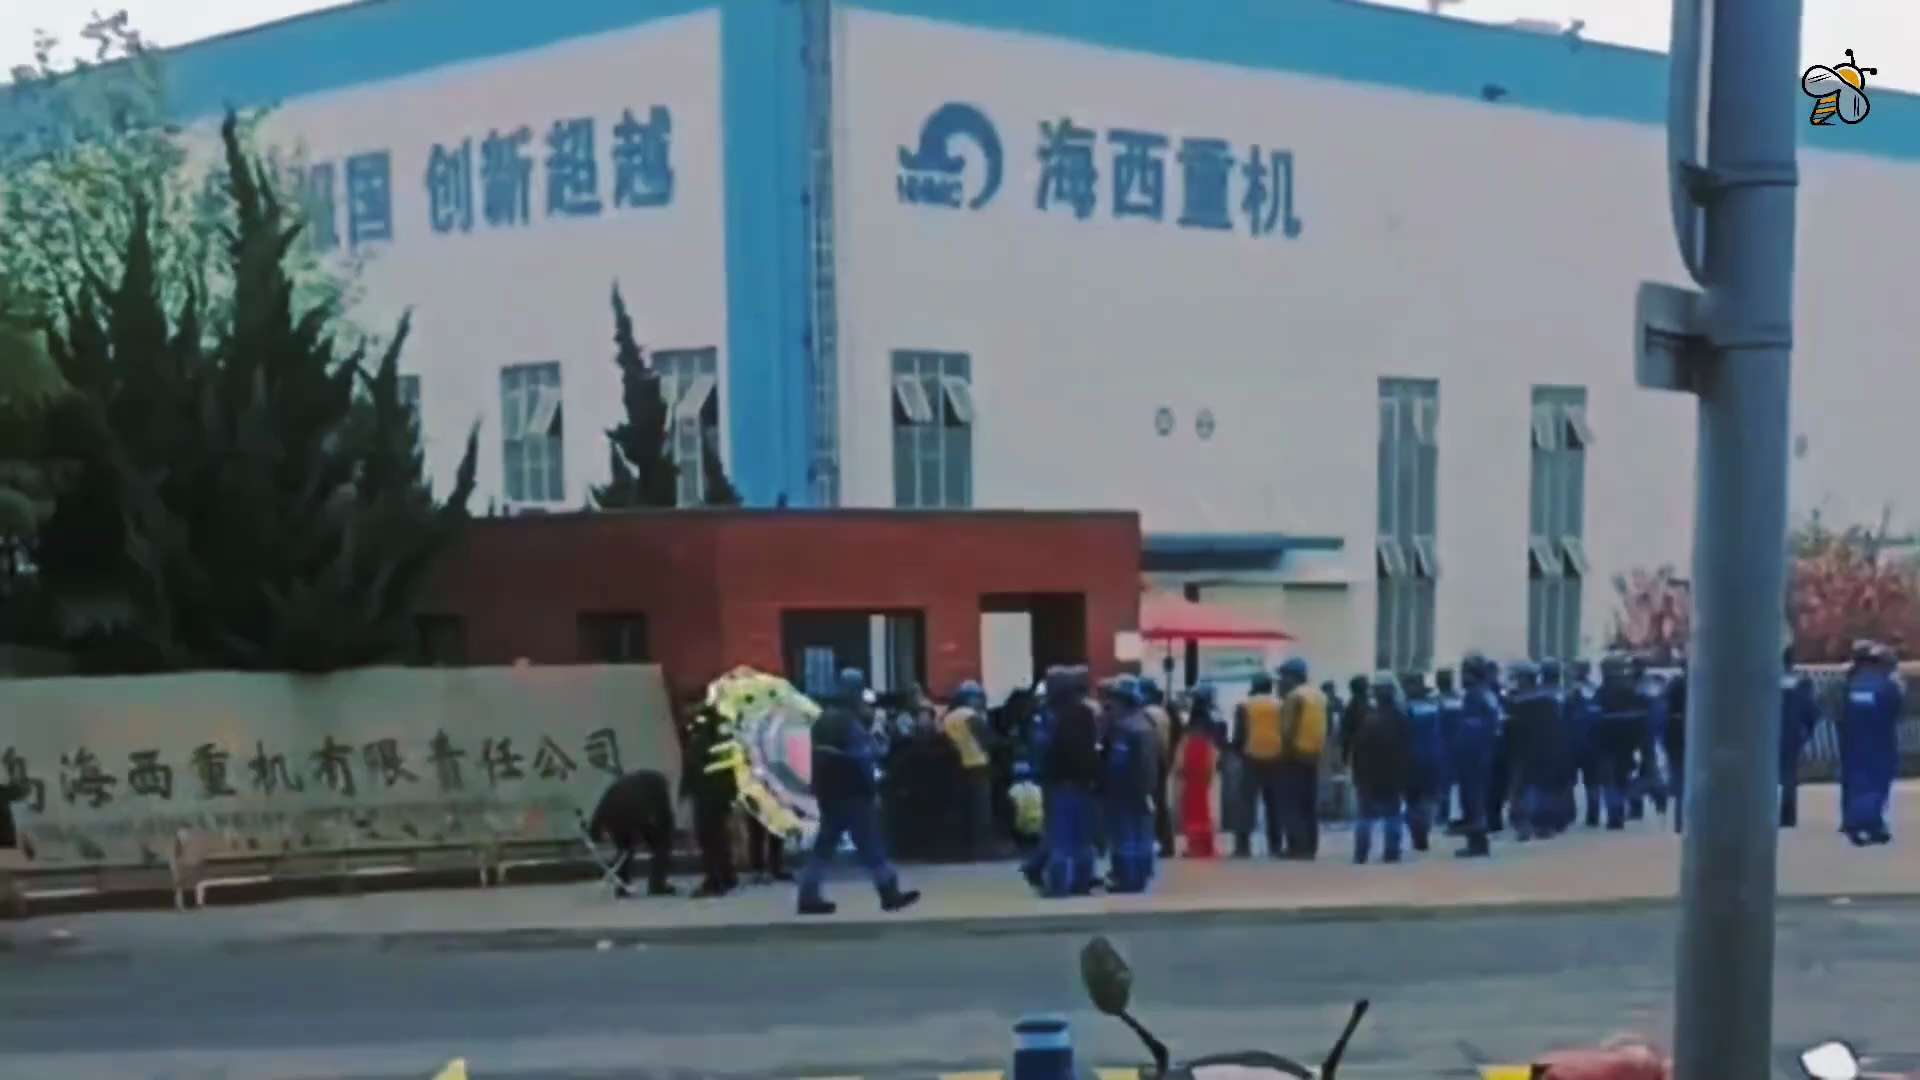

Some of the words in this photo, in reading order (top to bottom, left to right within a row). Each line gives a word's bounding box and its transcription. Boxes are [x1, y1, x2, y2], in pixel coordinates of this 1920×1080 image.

[426, 105, 675, 235] 创新超越
[1036, 117, 1302, 239] 海西重机
